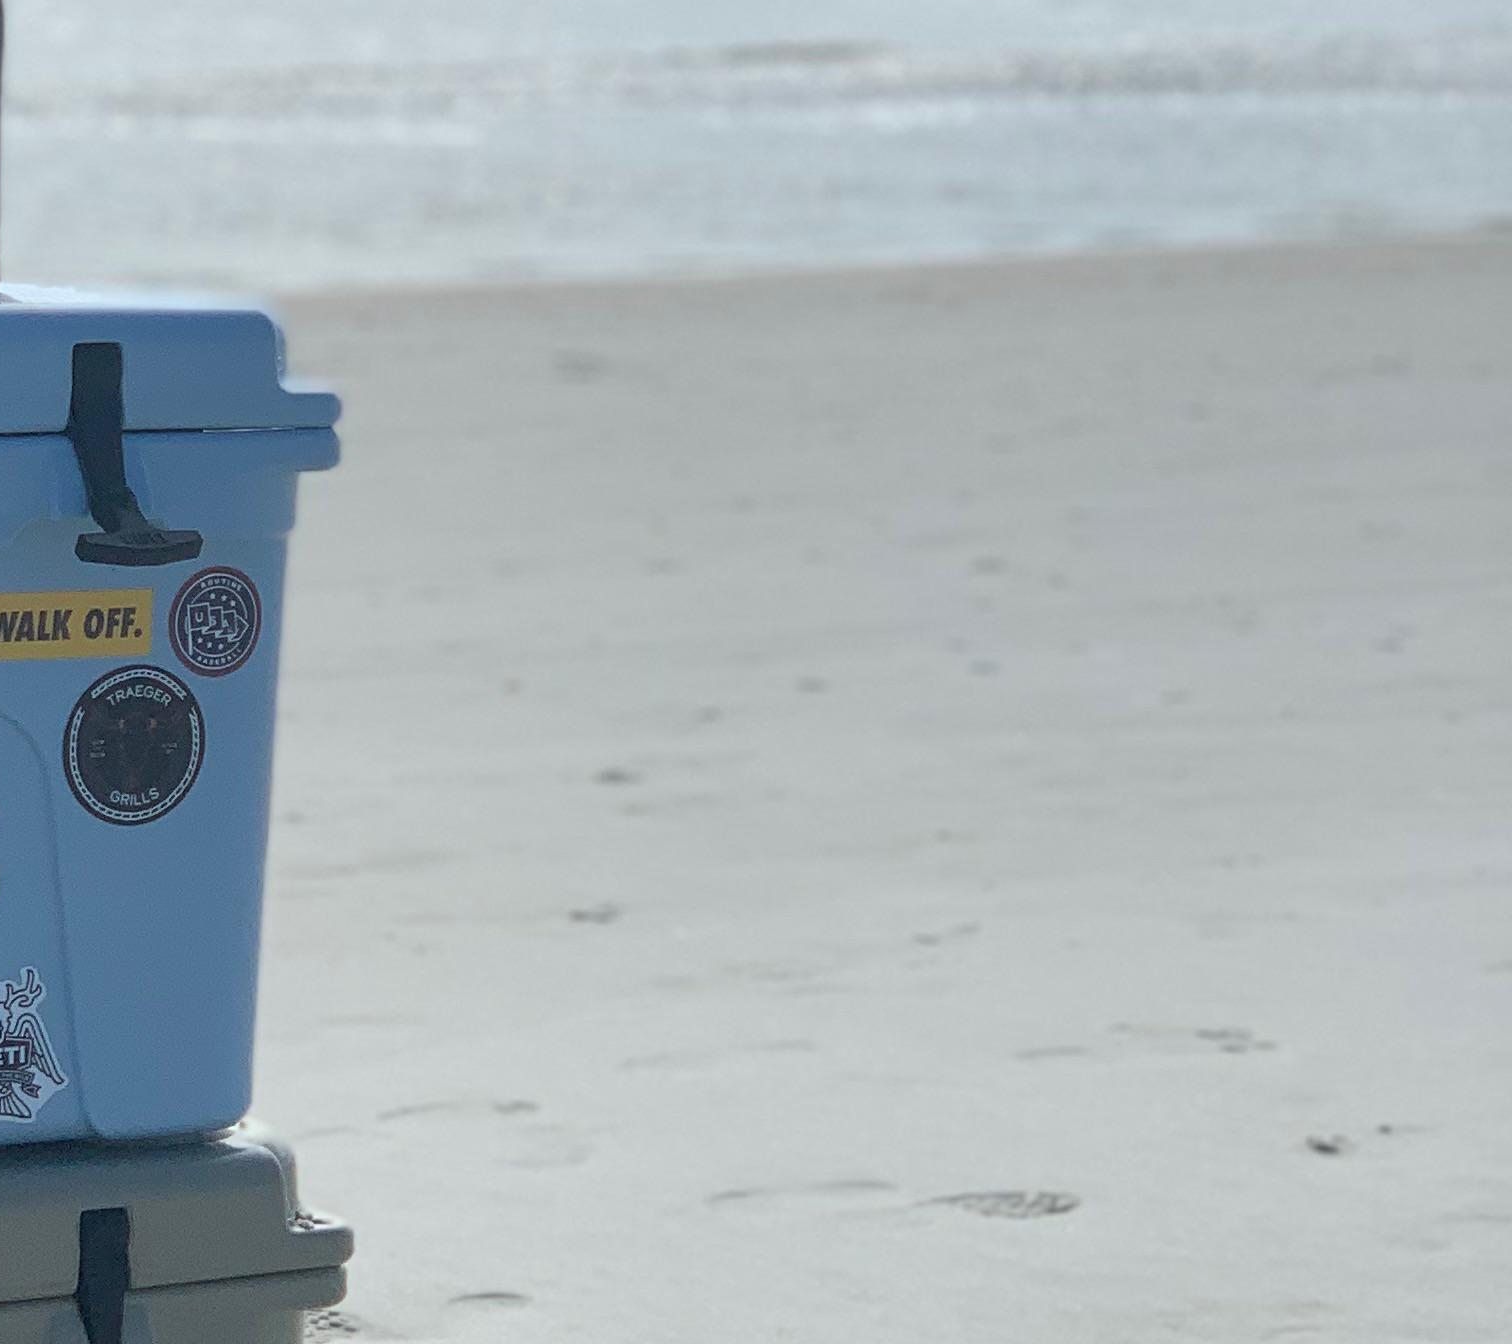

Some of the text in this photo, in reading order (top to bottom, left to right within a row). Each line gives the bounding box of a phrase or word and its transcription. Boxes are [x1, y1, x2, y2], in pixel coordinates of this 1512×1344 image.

[83, 607, 143, 639] OFF.
[196, 648, 242, 665] BASEBALL
[106, 685, 172, 707] TRAEGER
[110, 787, 160, 805] GRILLS
